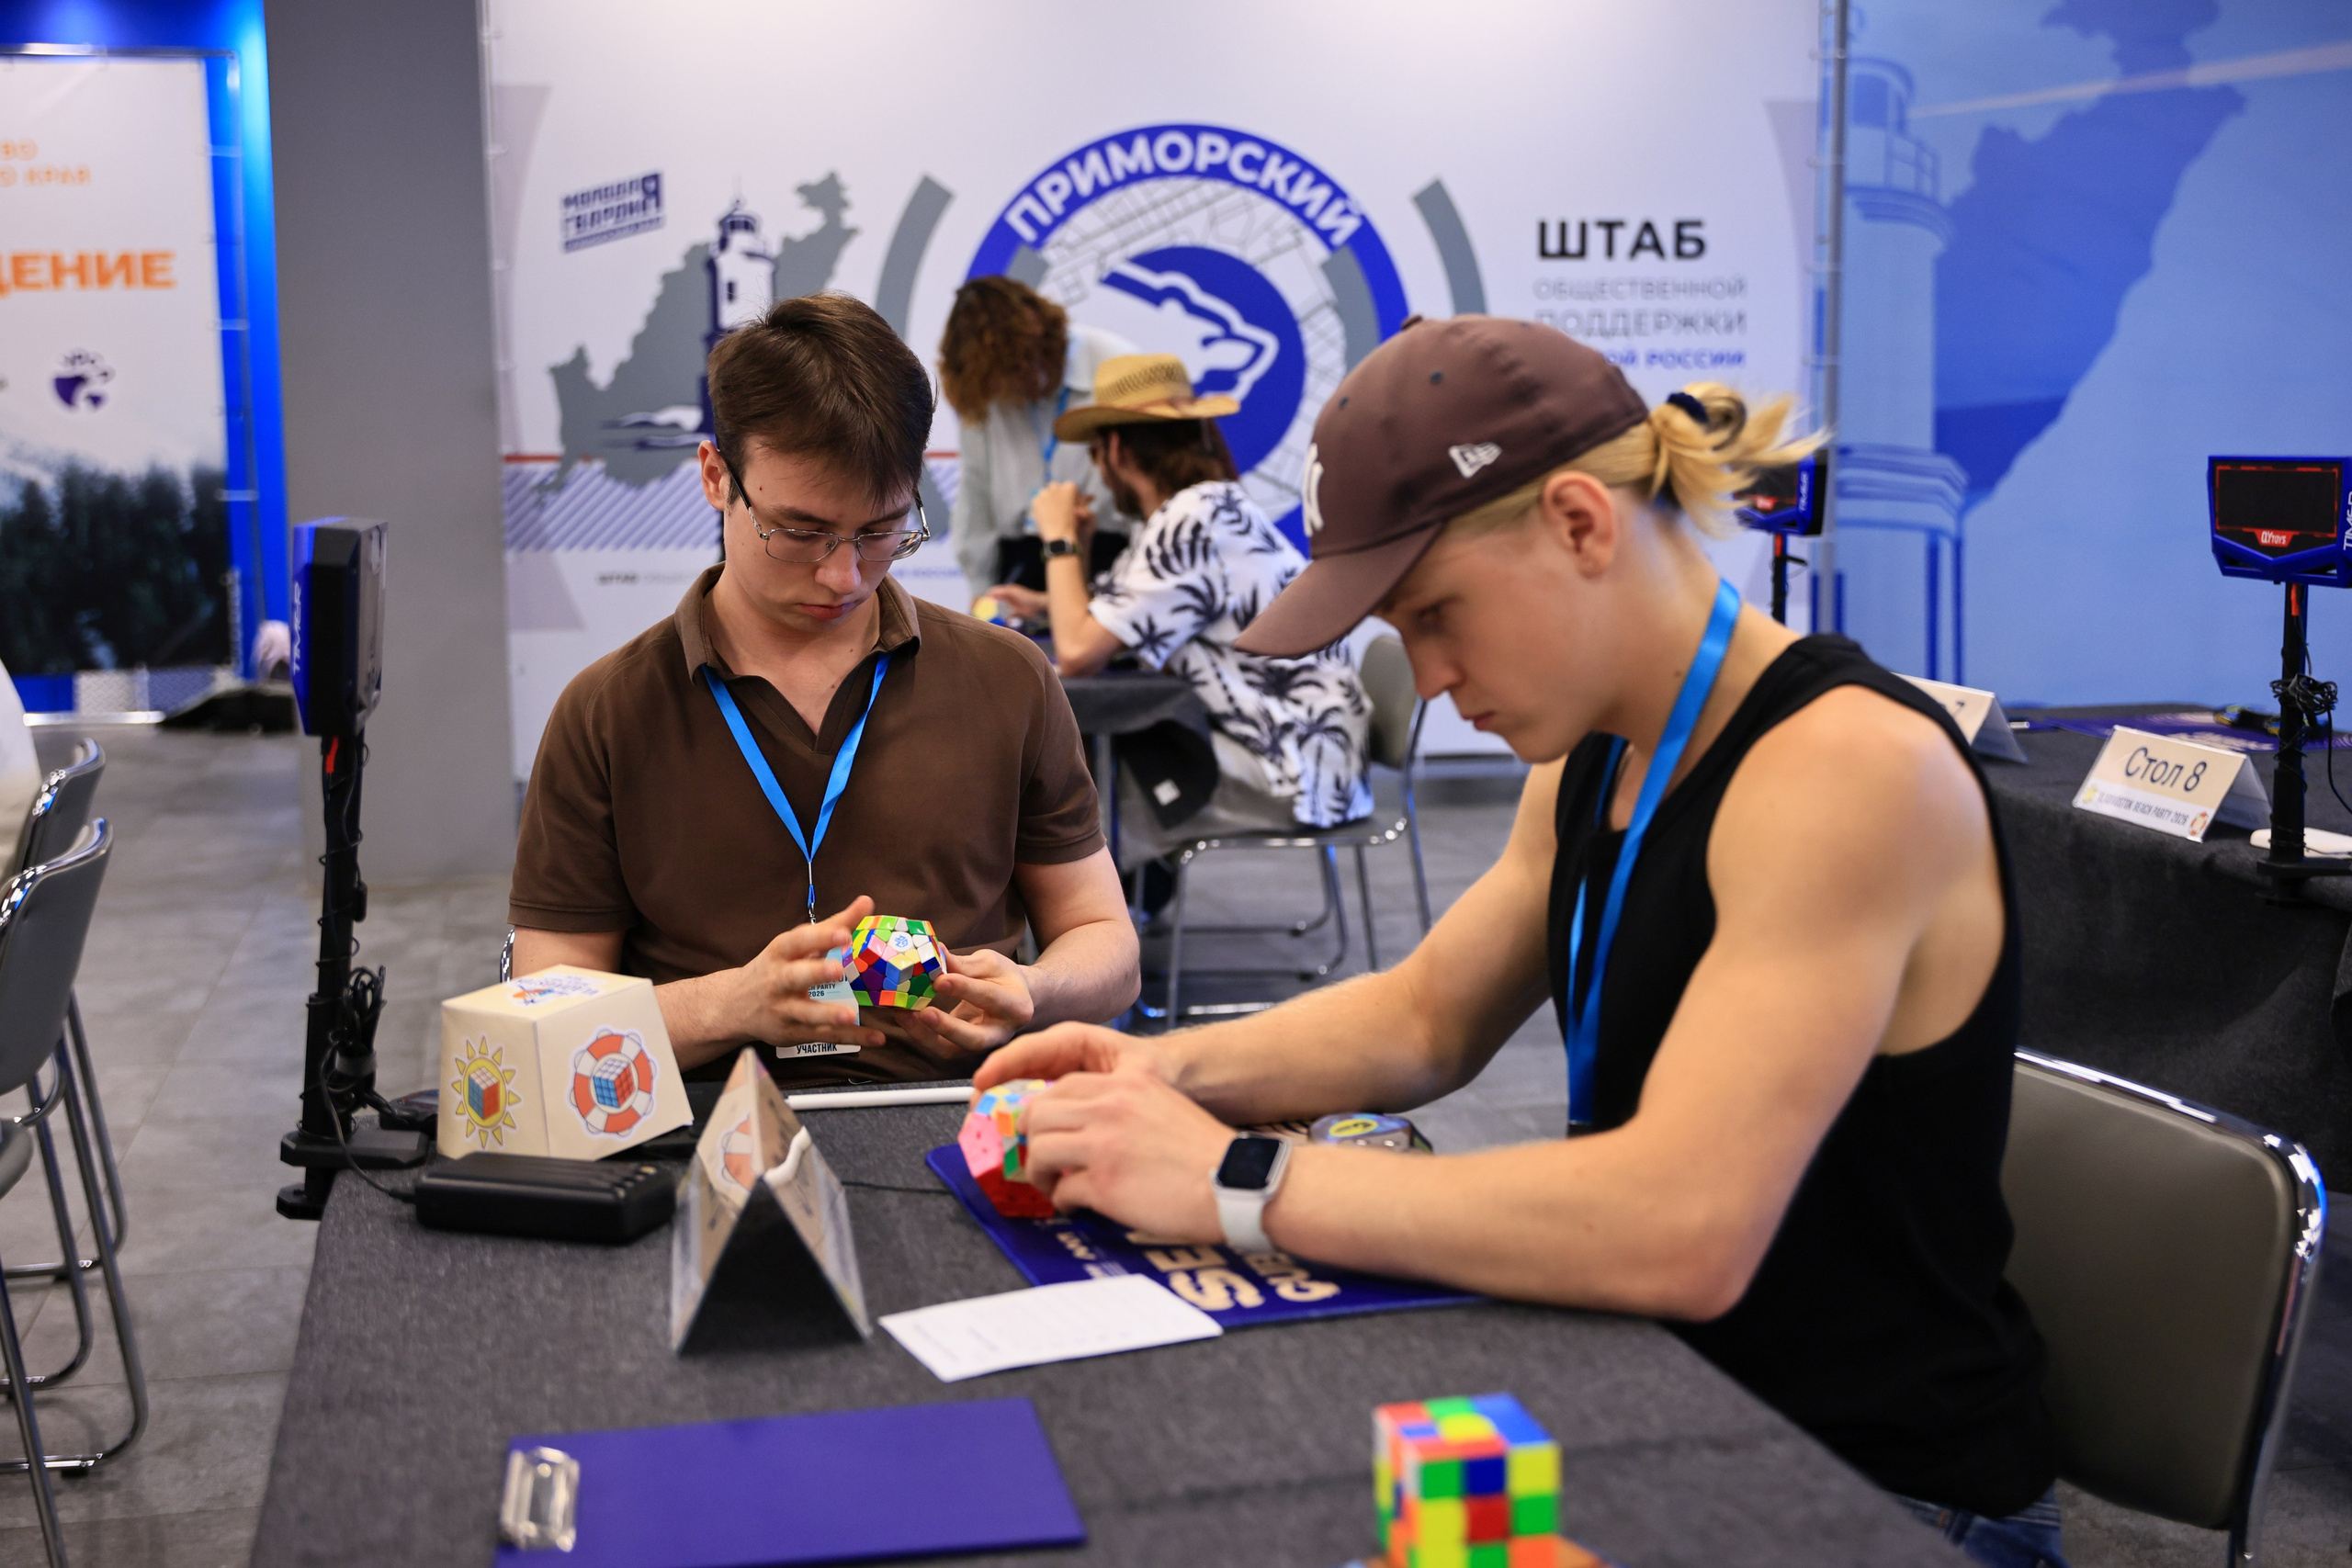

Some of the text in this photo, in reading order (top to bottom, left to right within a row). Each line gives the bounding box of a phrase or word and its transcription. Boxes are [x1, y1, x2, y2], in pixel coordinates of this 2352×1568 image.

[1005, 130, 1363, 247] ПРИМОРСКИЙ
[1537, 219, 1706, 261] ШТАБ
[293, 581, 302, 676] TIMER
[2125, 746, 2208, 792] Стол 8
[796, 1043, 838, 1055] УЧАСТНИК
